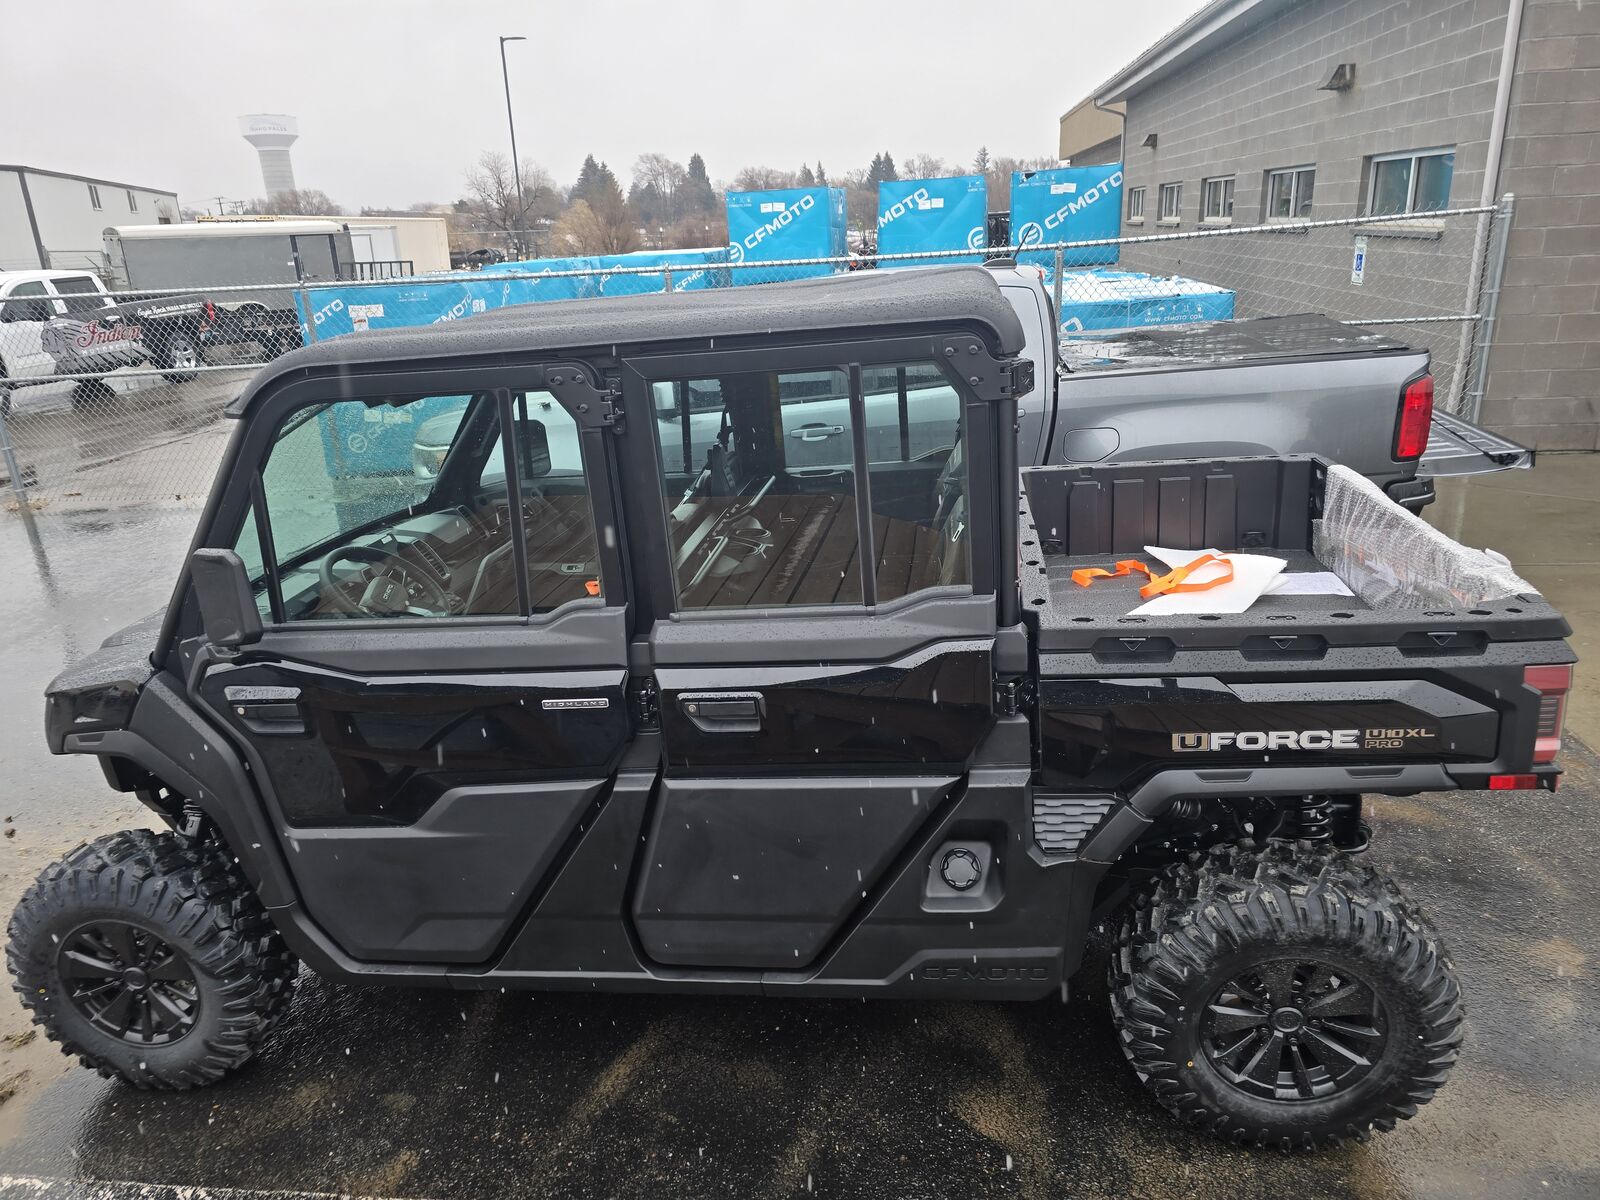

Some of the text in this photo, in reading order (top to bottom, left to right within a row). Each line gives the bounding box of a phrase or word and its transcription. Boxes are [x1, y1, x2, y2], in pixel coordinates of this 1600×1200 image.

[877, 188, 928, 228] MOTO
[1044, 171, 1123, 229] CFMOTO
[744, 195, 815, 249] CFMOTO
[75, 320, 143, 349] Indian
[1365, 739, 1404, 749] PRO
[922, 968, 1049, 981] CFMOTO
